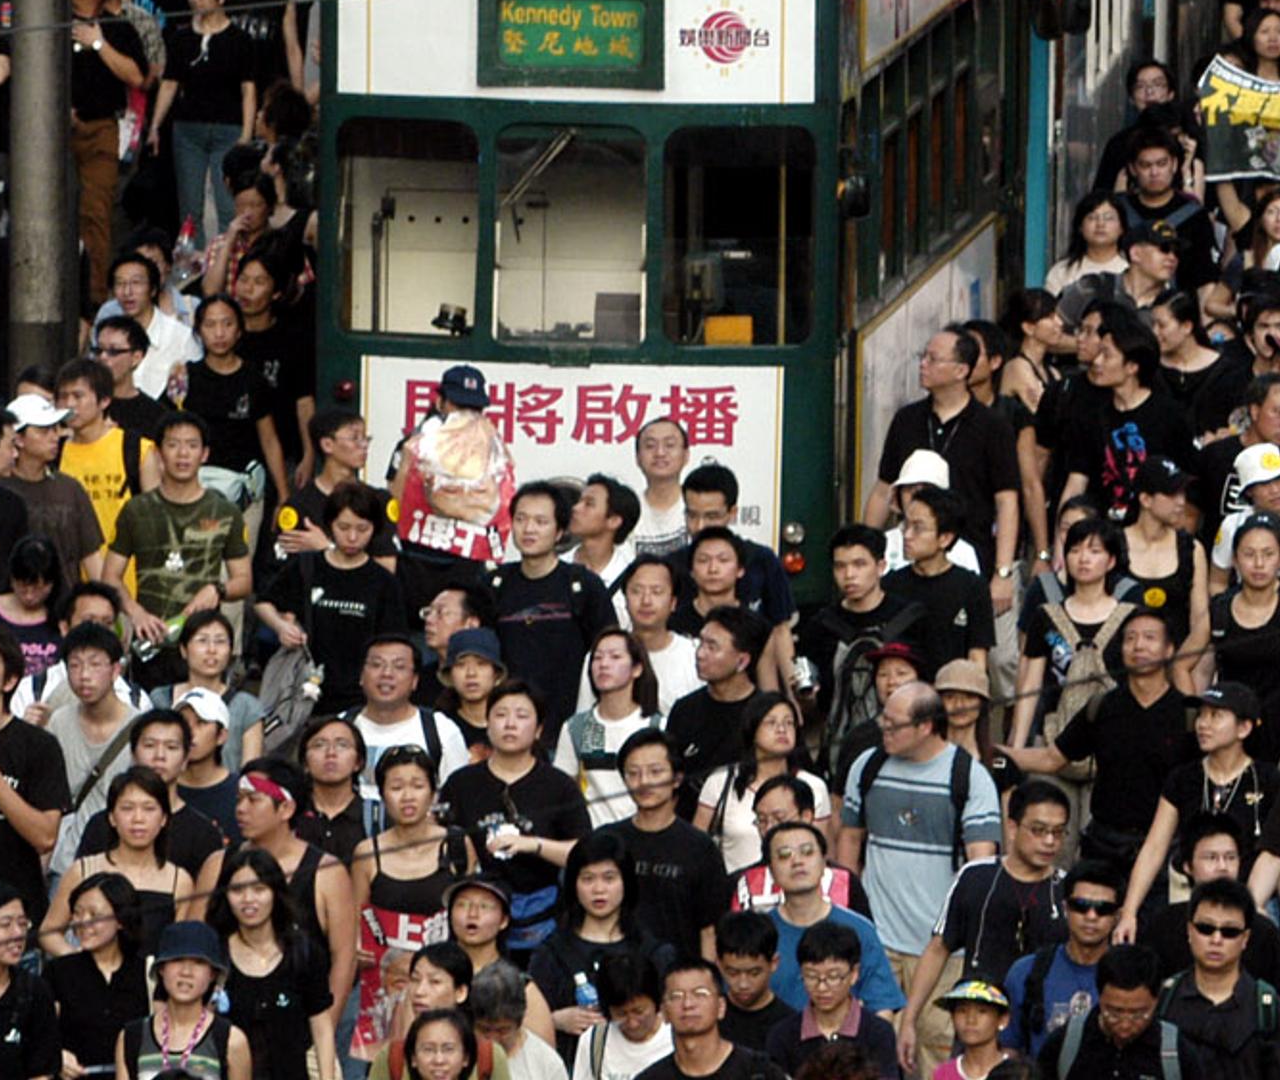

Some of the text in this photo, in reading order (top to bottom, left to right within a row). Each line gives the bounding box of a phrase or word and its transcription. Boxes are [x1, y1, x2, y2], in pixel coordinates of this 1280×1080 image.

[501, 1, 639, 29] Kennedy Town
[503, 33, 634, 59] 堅尼地城
[678, 27, 771, 48] 娛樂新聞台
